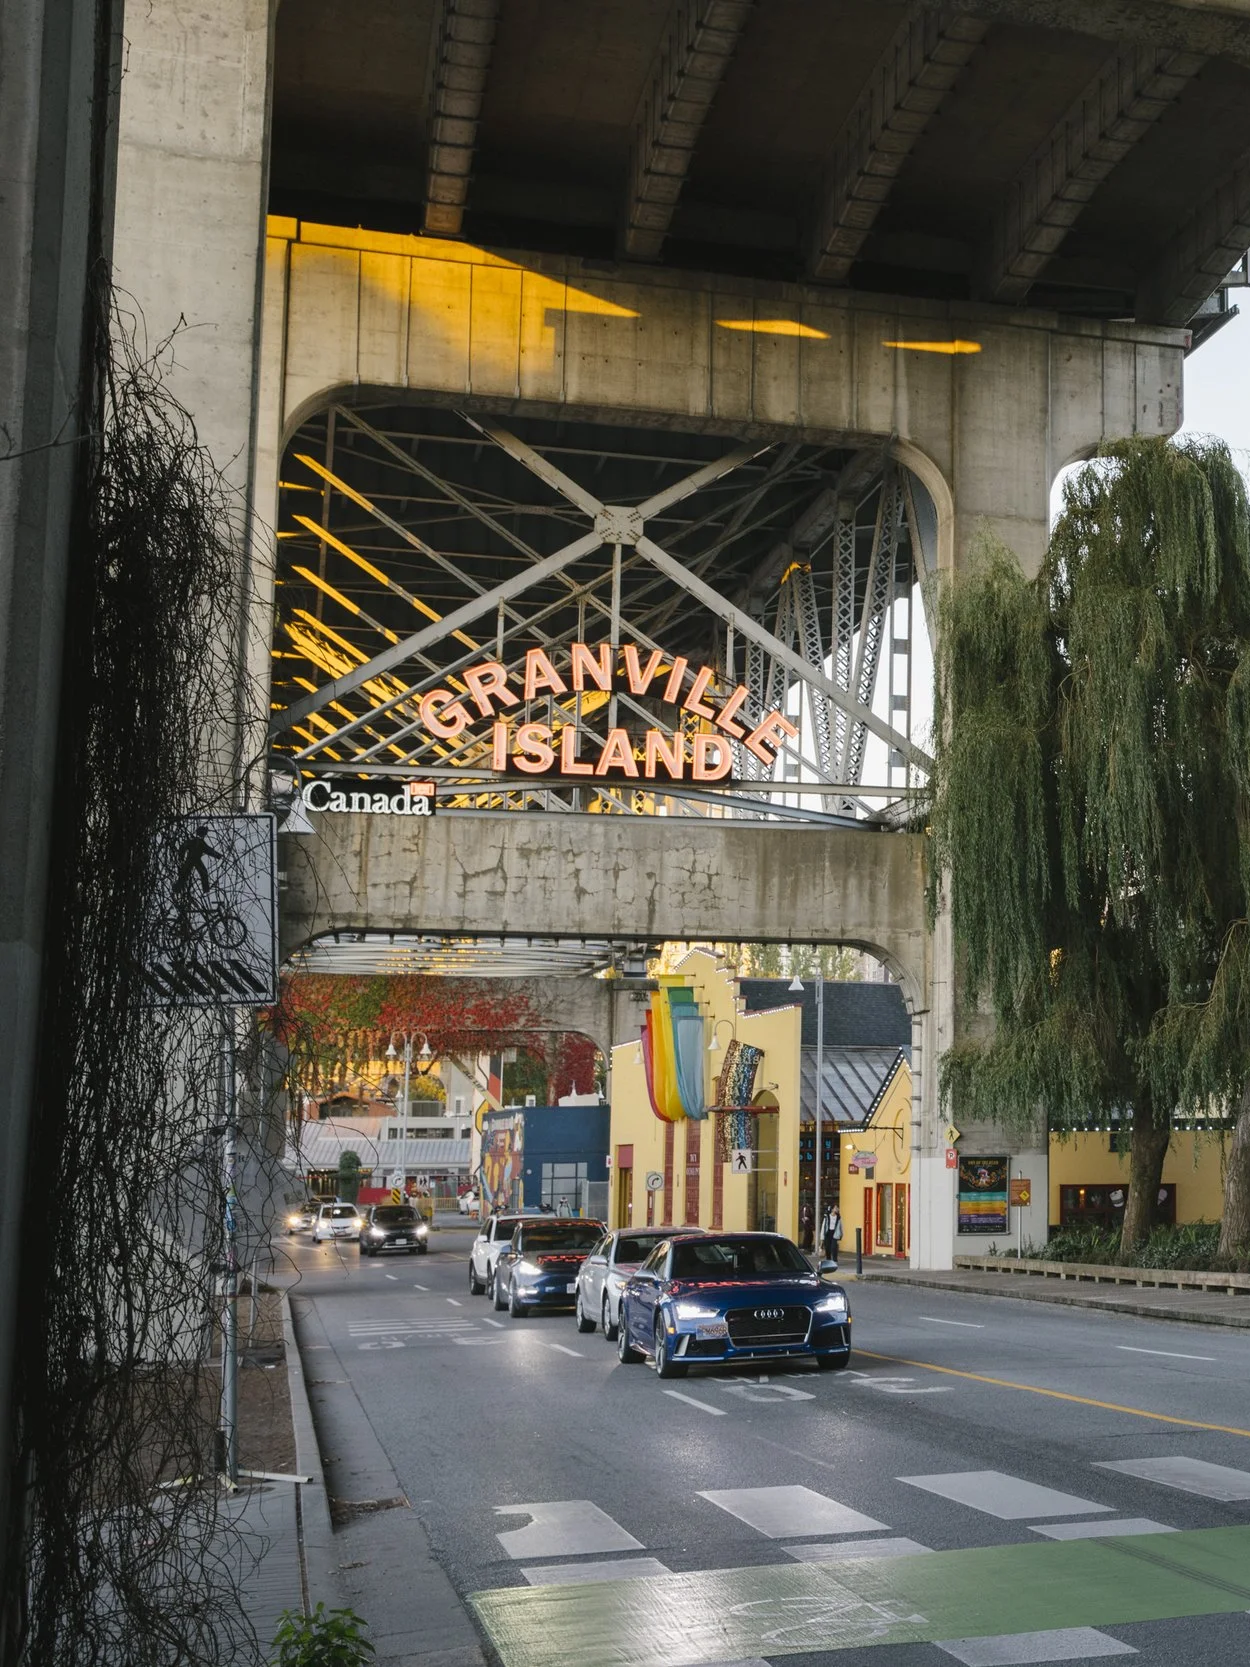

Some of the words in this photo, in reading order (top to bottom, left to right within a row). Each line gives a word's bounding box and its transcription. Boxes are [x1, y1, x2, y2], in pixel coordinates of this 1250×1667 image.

[419, 642, 800, 766] GRANVILLE
[492, 722, 733, 781] ISLAND
[301, 780, 432, 816] Canada
